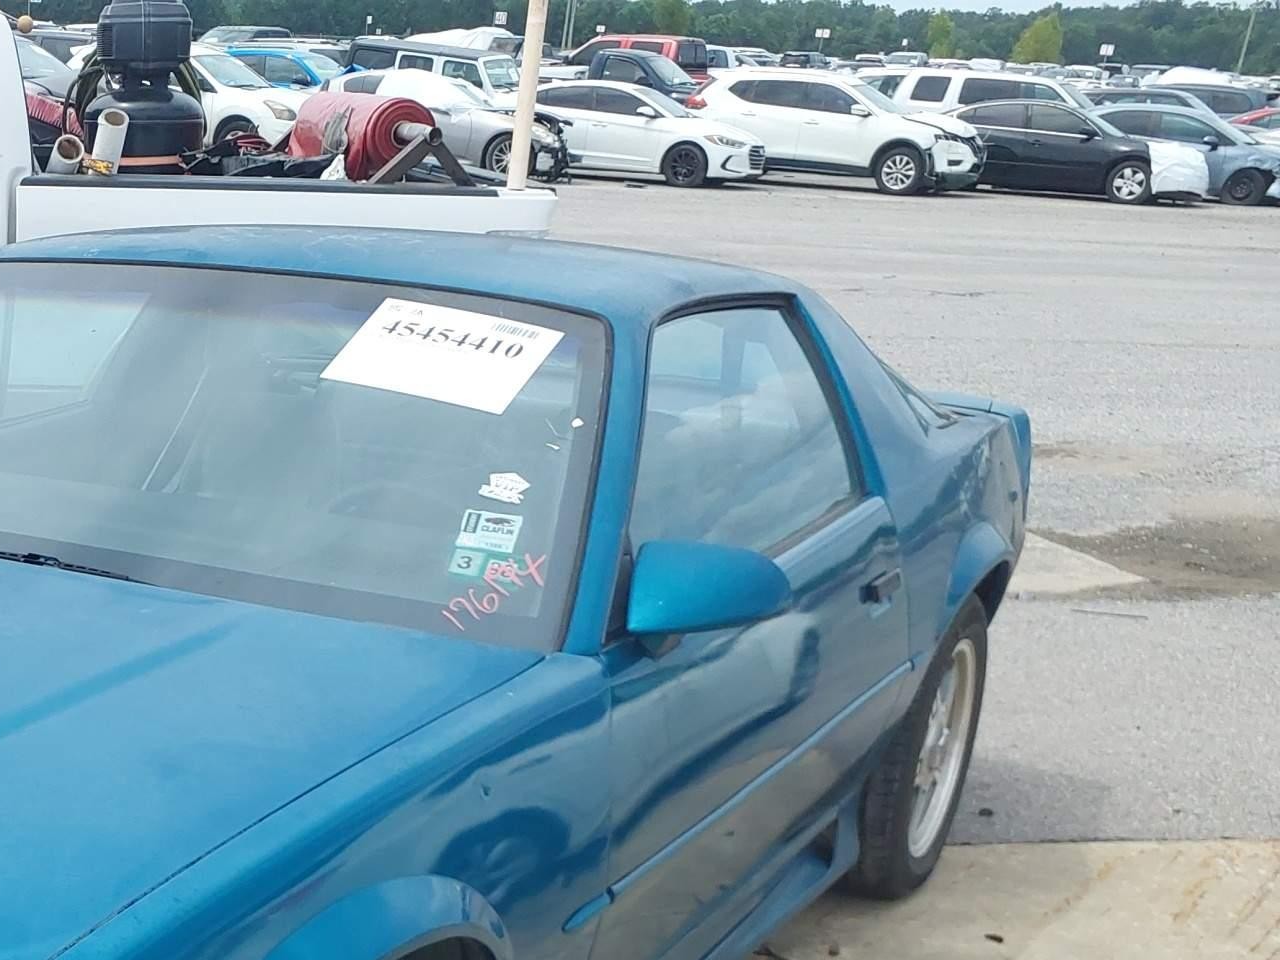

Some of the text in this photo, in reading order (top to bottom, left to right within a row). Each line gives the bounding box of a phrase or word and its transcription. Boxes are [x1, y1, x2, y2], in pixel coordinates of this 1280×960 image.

[382, 320, 524, 359] 45454410
[481, 525, 515, 536] CLAFLIN
[456, 555, 473, 570] 3
